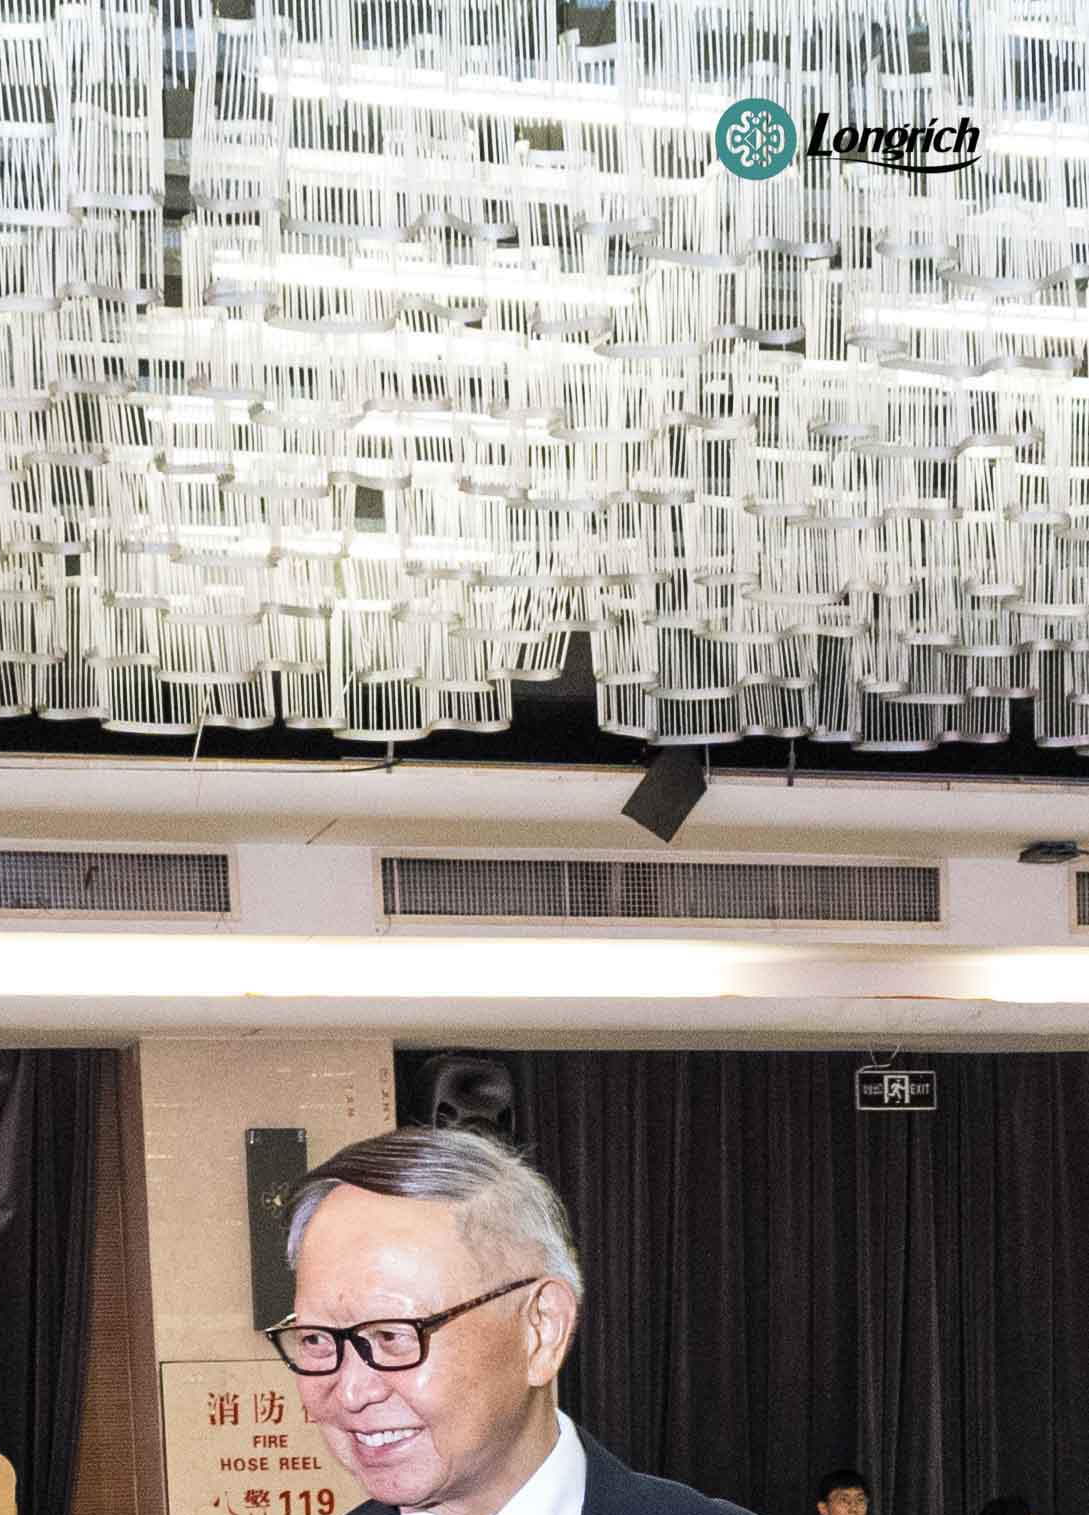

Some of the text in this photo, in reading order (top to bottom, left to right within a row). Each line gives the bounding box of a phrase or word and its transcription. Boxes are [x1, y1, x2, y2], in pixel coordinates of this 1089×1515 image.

[910, 1083, 930, 1096] EXIT
[208, 1391, 316, 1426] 消防
[253, 1434, 289, 1449] FIRE
[220, 1457, 322, 1471] HOSE REEL
